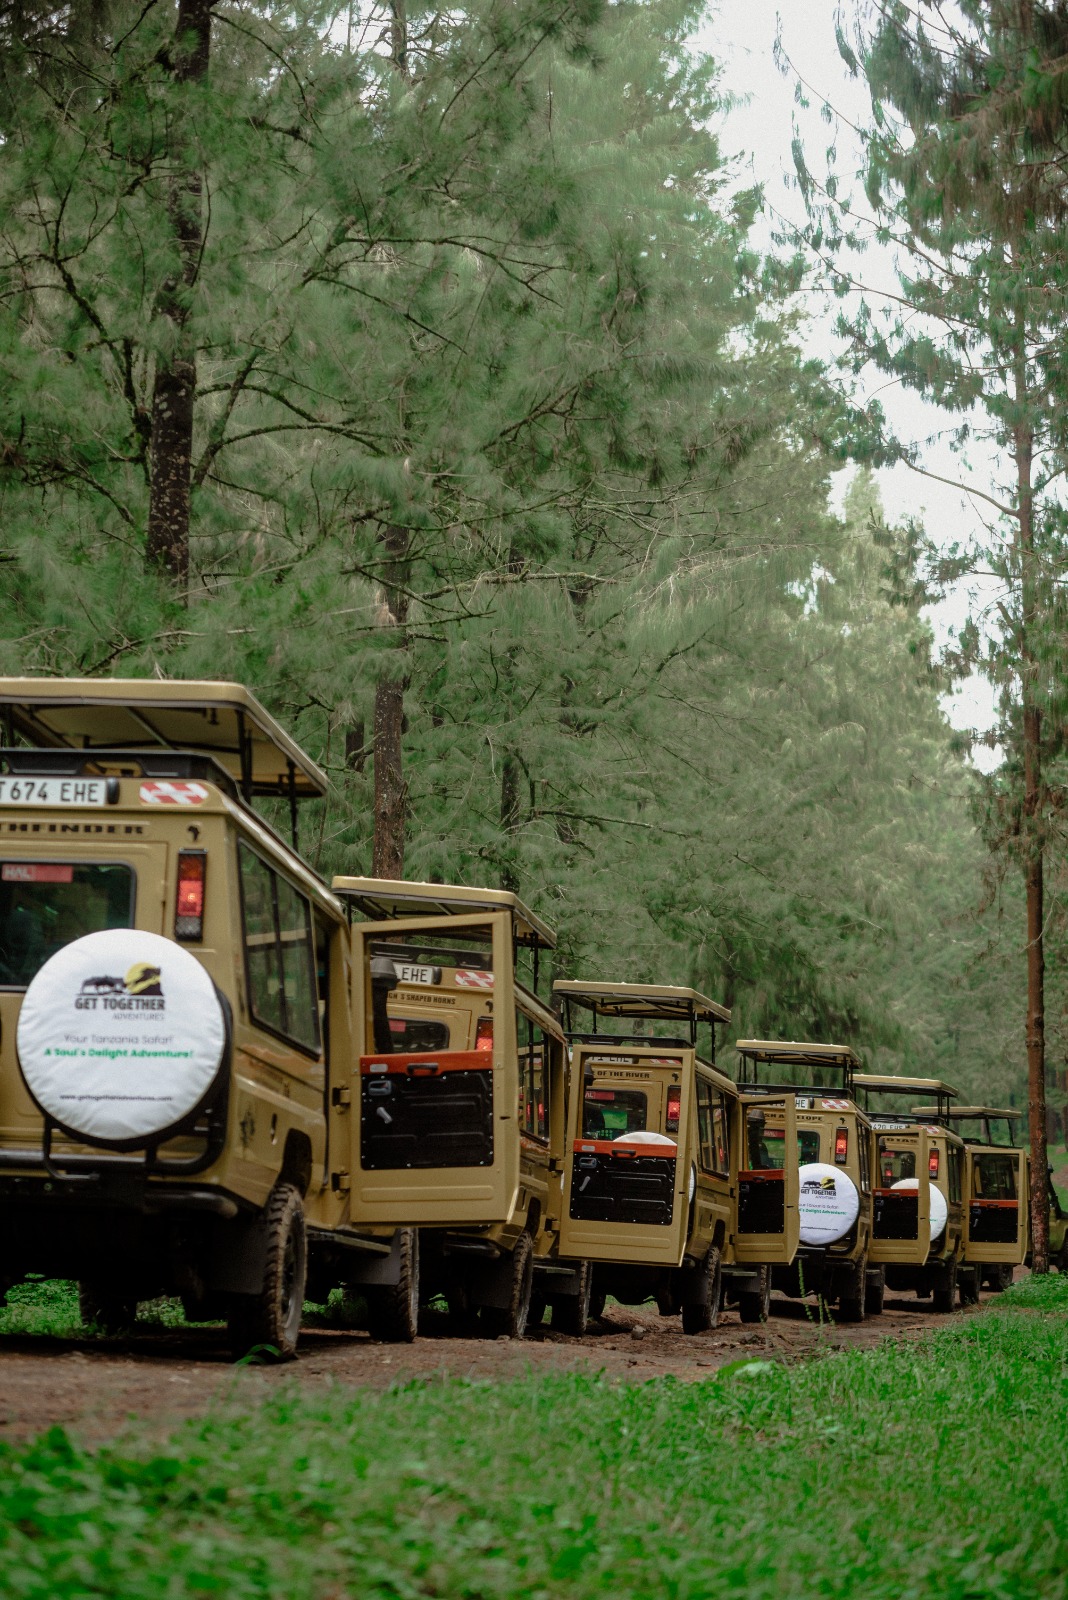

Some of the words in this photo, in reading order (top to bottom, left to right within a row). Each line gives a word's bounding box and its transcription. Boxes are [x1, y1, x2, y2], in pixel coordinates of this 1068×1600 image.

[10, 781, 48, 801] 674
[60, 782, 99, 802] EHE
[0, 823, 143, 834] HFINDER
[401, 967, 428, 983] EHE
[74, 997, 98, 1011] GET
[103, 997, 166, 1012] TOGETHER
[406, 994, 432, 1003] SHAPED
[433, 995, 456, 1005] HORNS
[112, 1012, 165, 1021] ADVENTURES
[63, 1034, 89, 1044] Your
[91, 1034, 140, 1046] Tanzania
[142, 1035, 175, 1046] Safari
[44, 1048, 52, 1057] A
[88, 1048, 129, 1060] Delight
[795, 1099, 806, 1108] HE
[811, 1189, 837, 1197] TOGETHER
